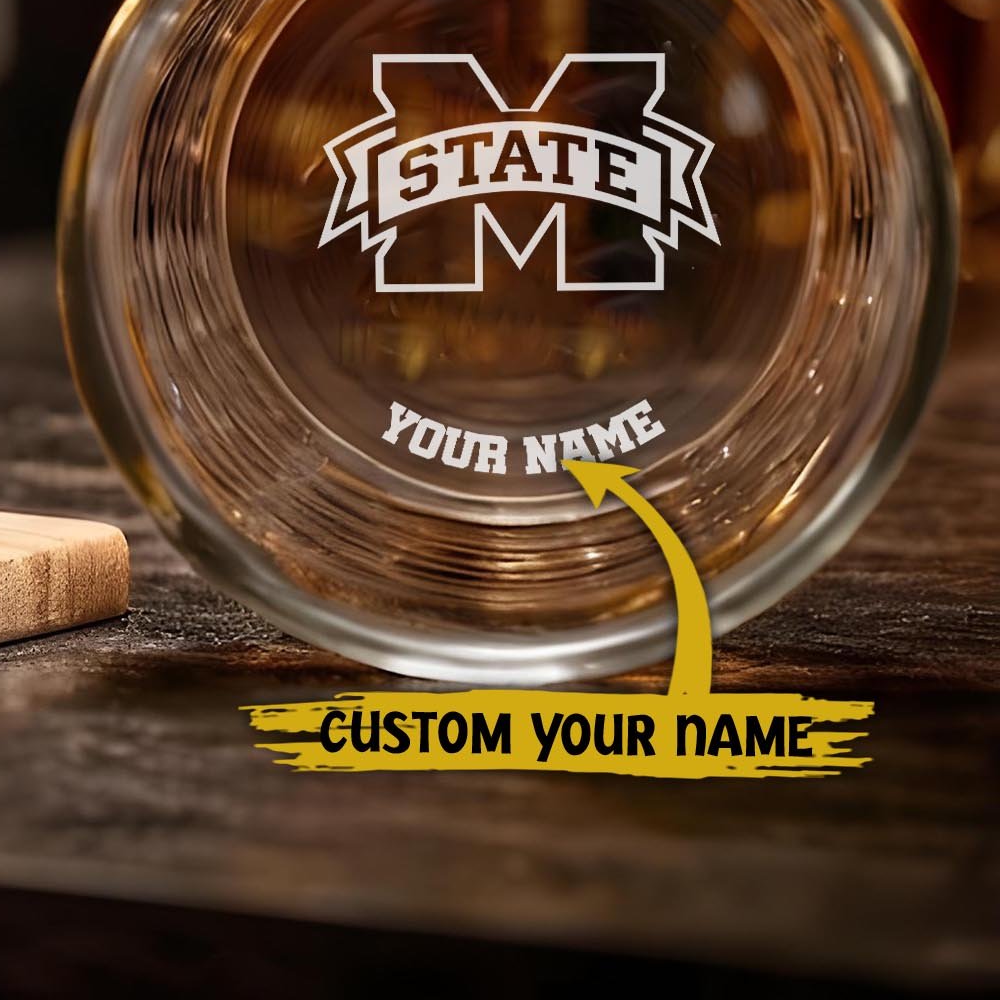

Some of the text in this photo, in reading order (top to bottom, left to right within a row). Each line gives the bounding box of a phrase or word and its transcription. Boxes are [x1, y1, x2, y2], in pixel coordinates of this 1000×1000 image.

[399, 129, 637, 204] STATE
[381, 399, 667, 475] YOUR NAME
